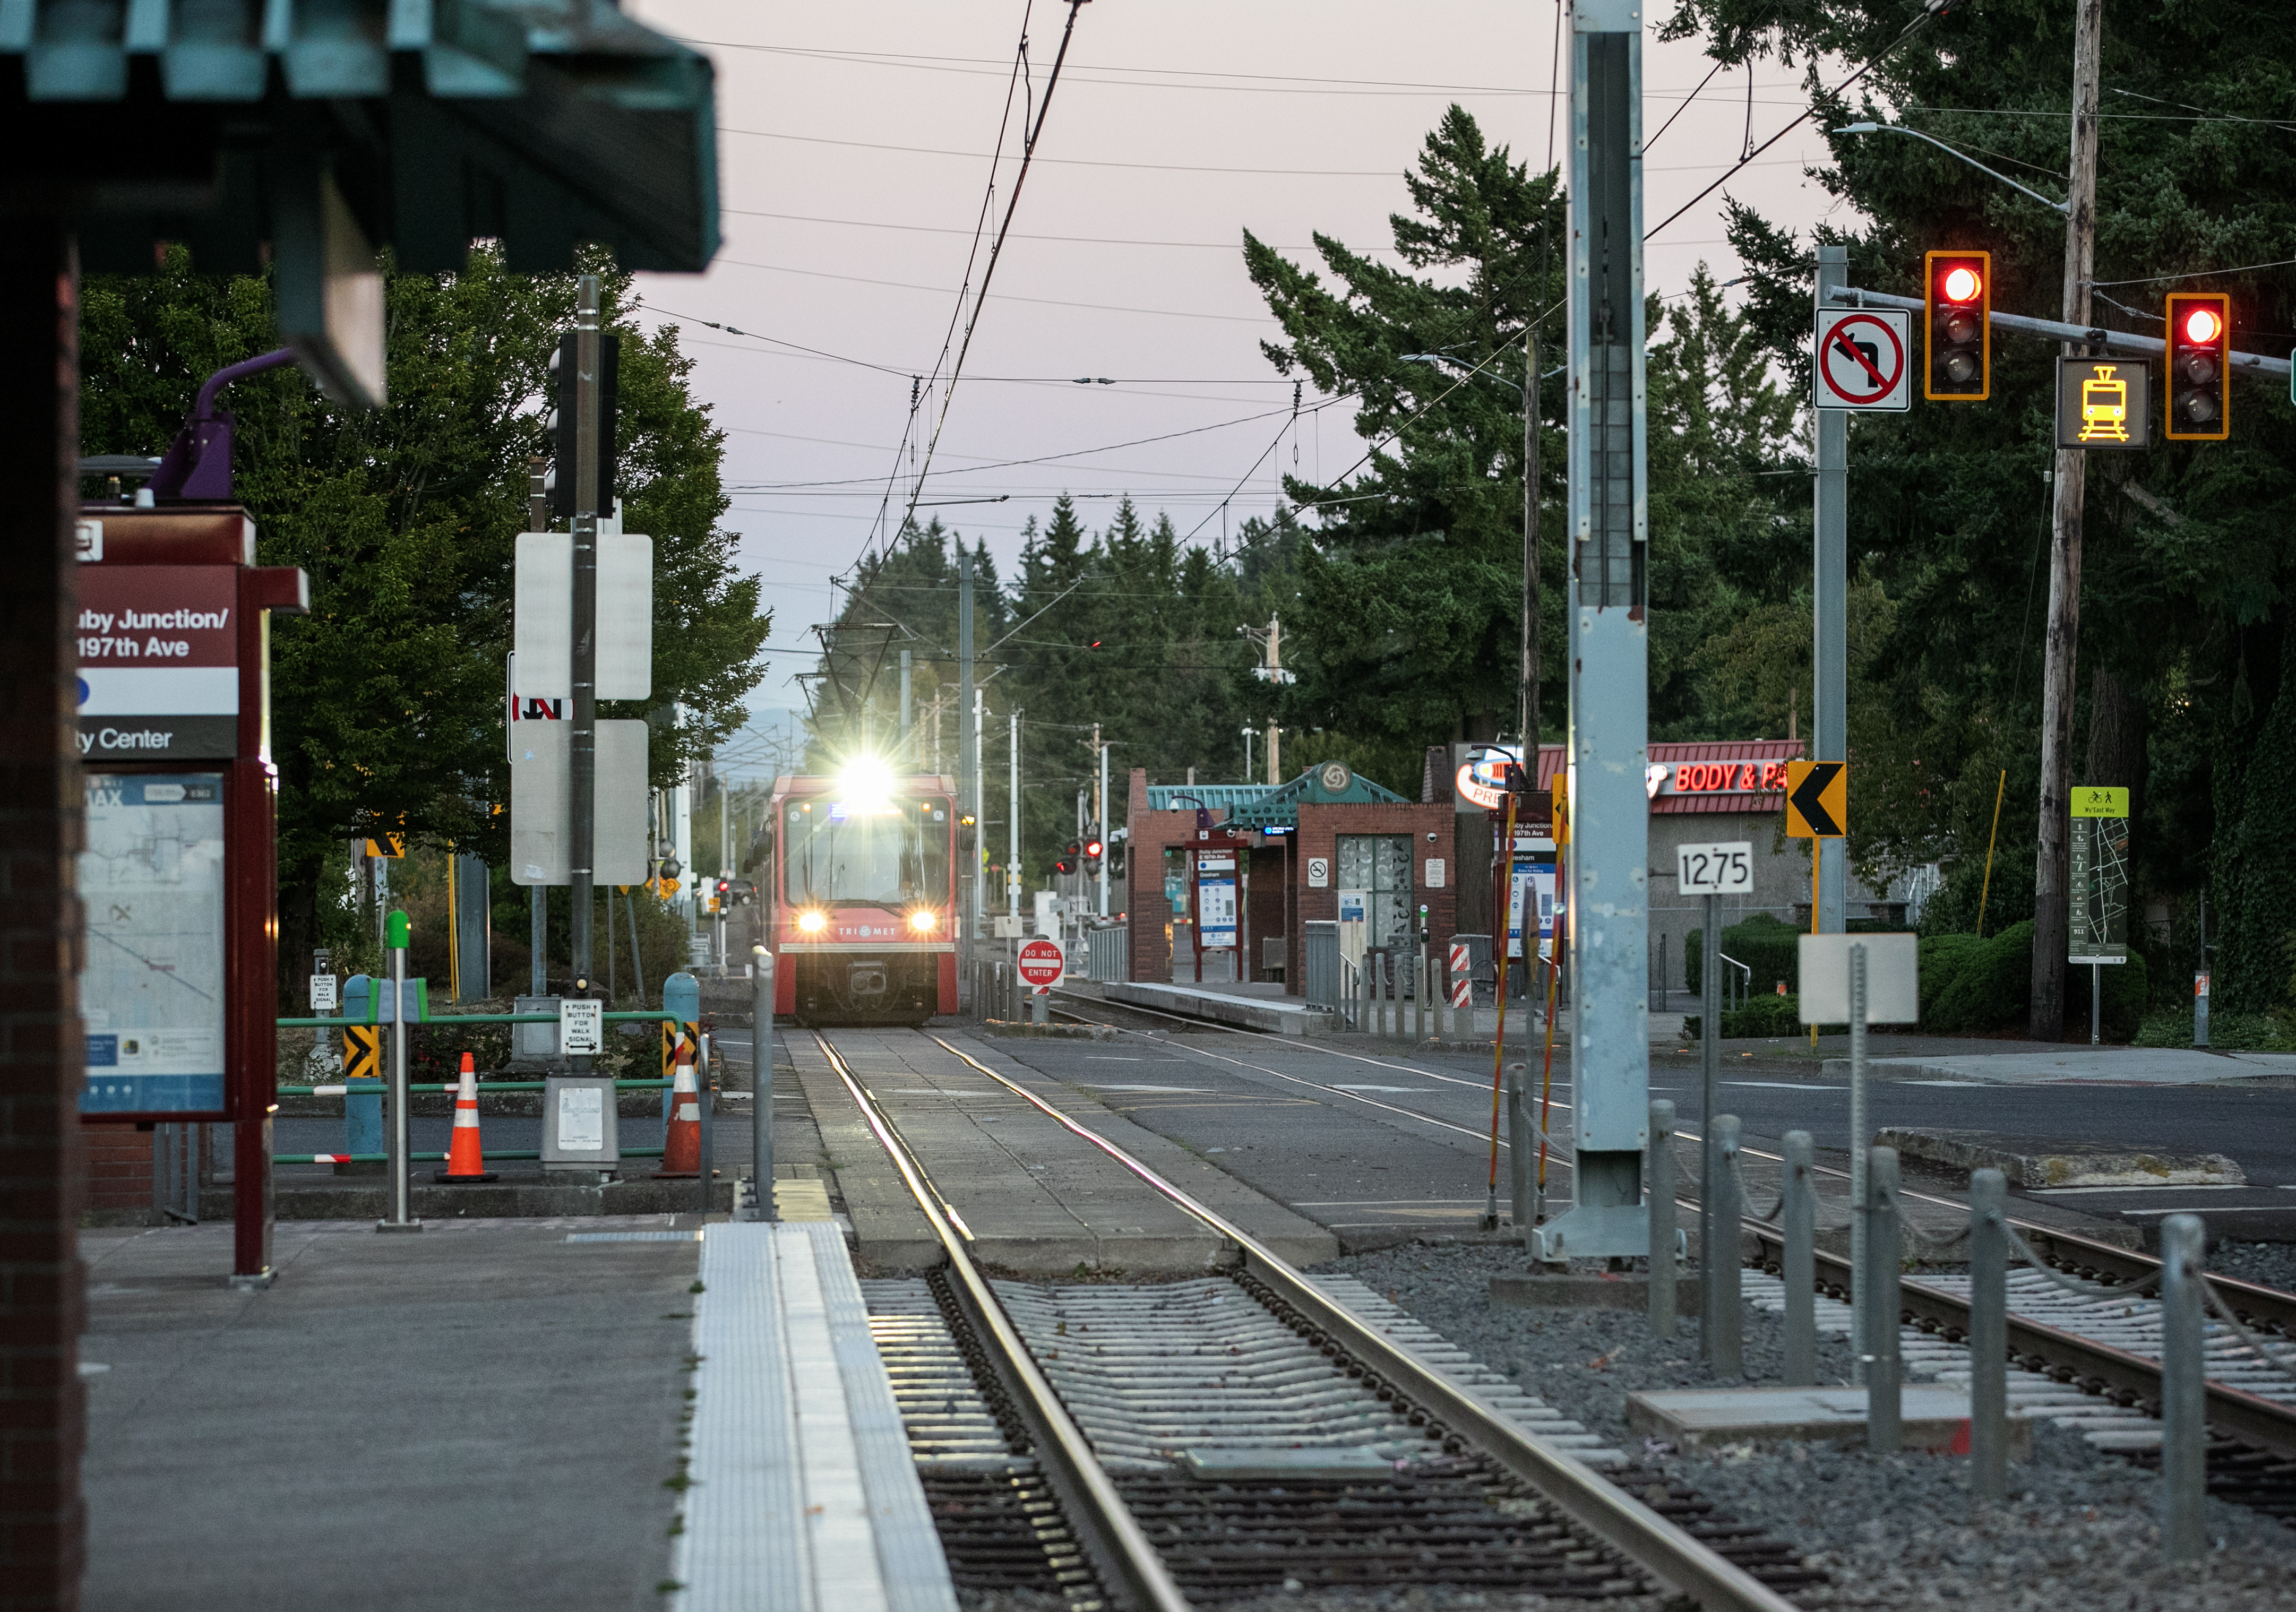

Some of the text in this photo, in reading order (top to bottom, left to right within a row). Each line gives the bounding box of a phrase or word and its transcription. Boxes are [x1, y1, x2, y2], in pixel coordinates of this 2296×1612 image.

[118, 608, 229, 629] Junction/
[144, 637, 190, 657] Ave
[99, 728, 173, 749] Center
[1675, 764, 1737, 791] BODY
[1740, 763, 1755, 790] &
[1473, 788, 1499, 803] PRE
